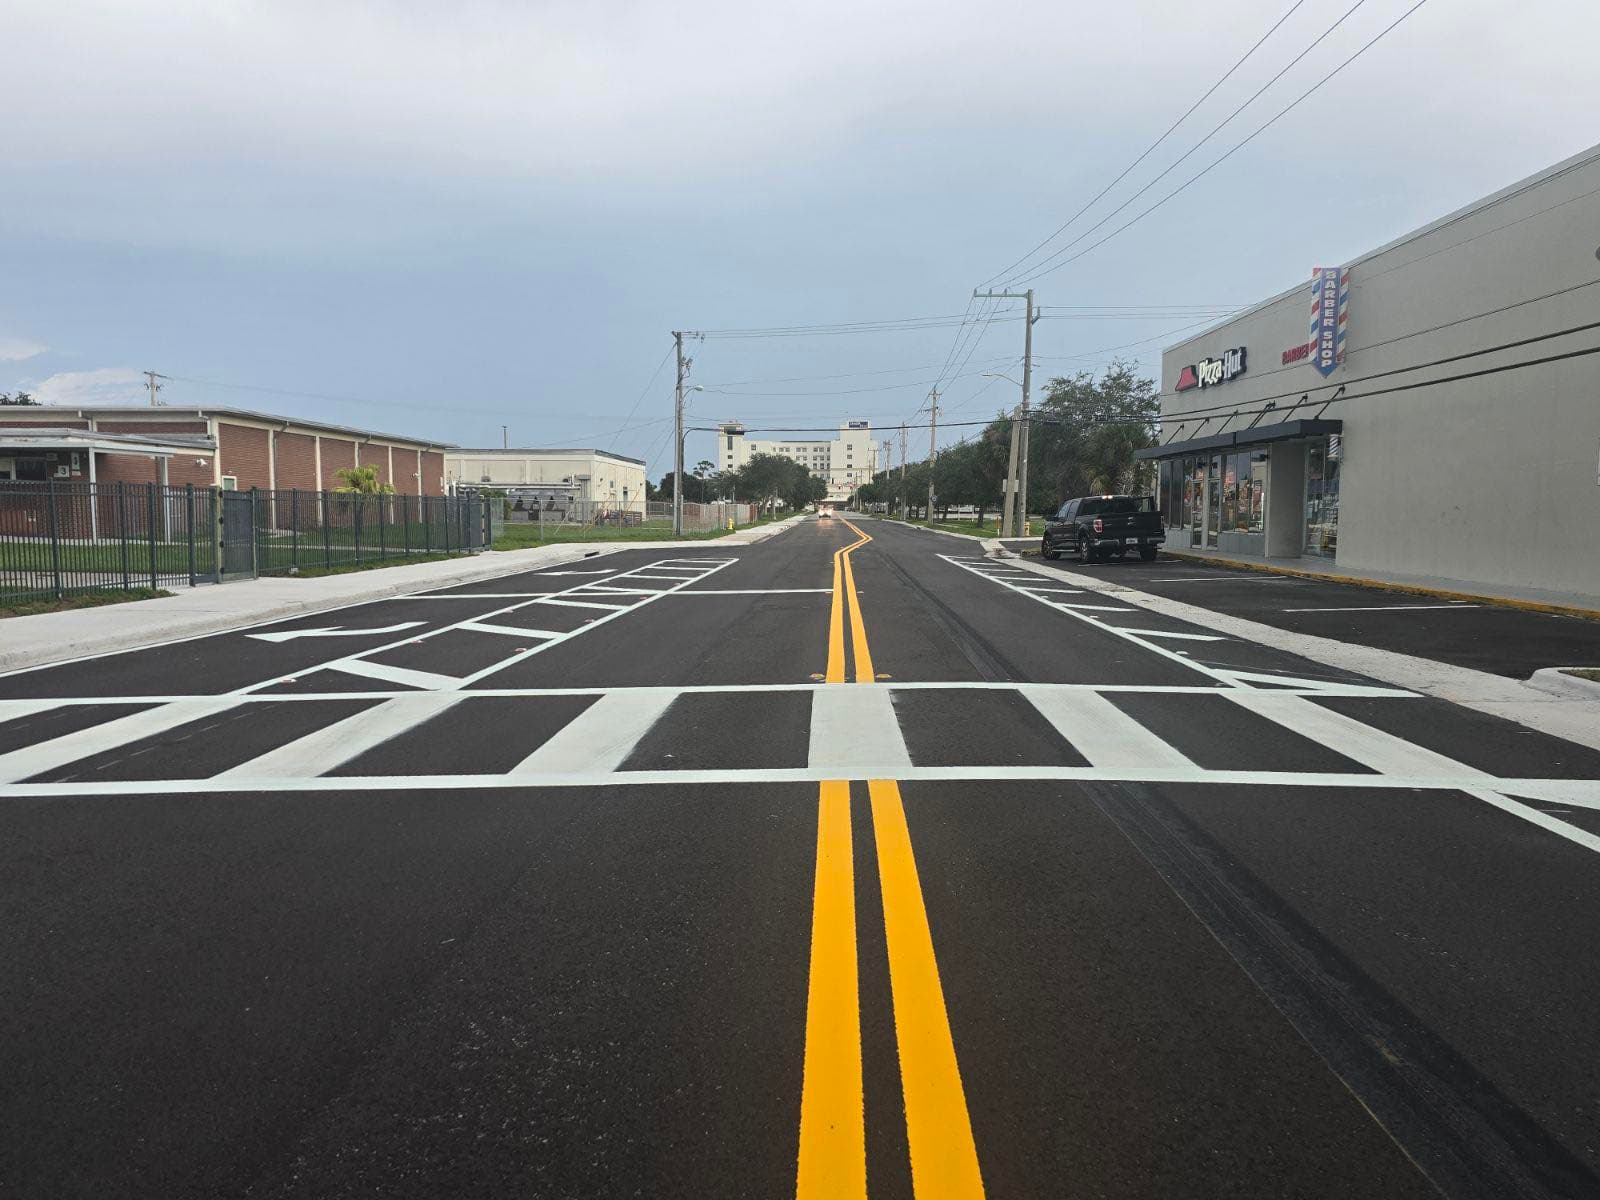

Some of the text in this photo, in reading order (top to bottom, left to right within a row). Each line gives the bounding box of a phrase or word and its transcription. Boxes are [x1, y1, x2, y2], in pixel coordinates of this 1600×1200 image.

[1321, 270, 1336, 368] BARBER SHOP
[1198, 349, 1242, 388] Pizza Hut
